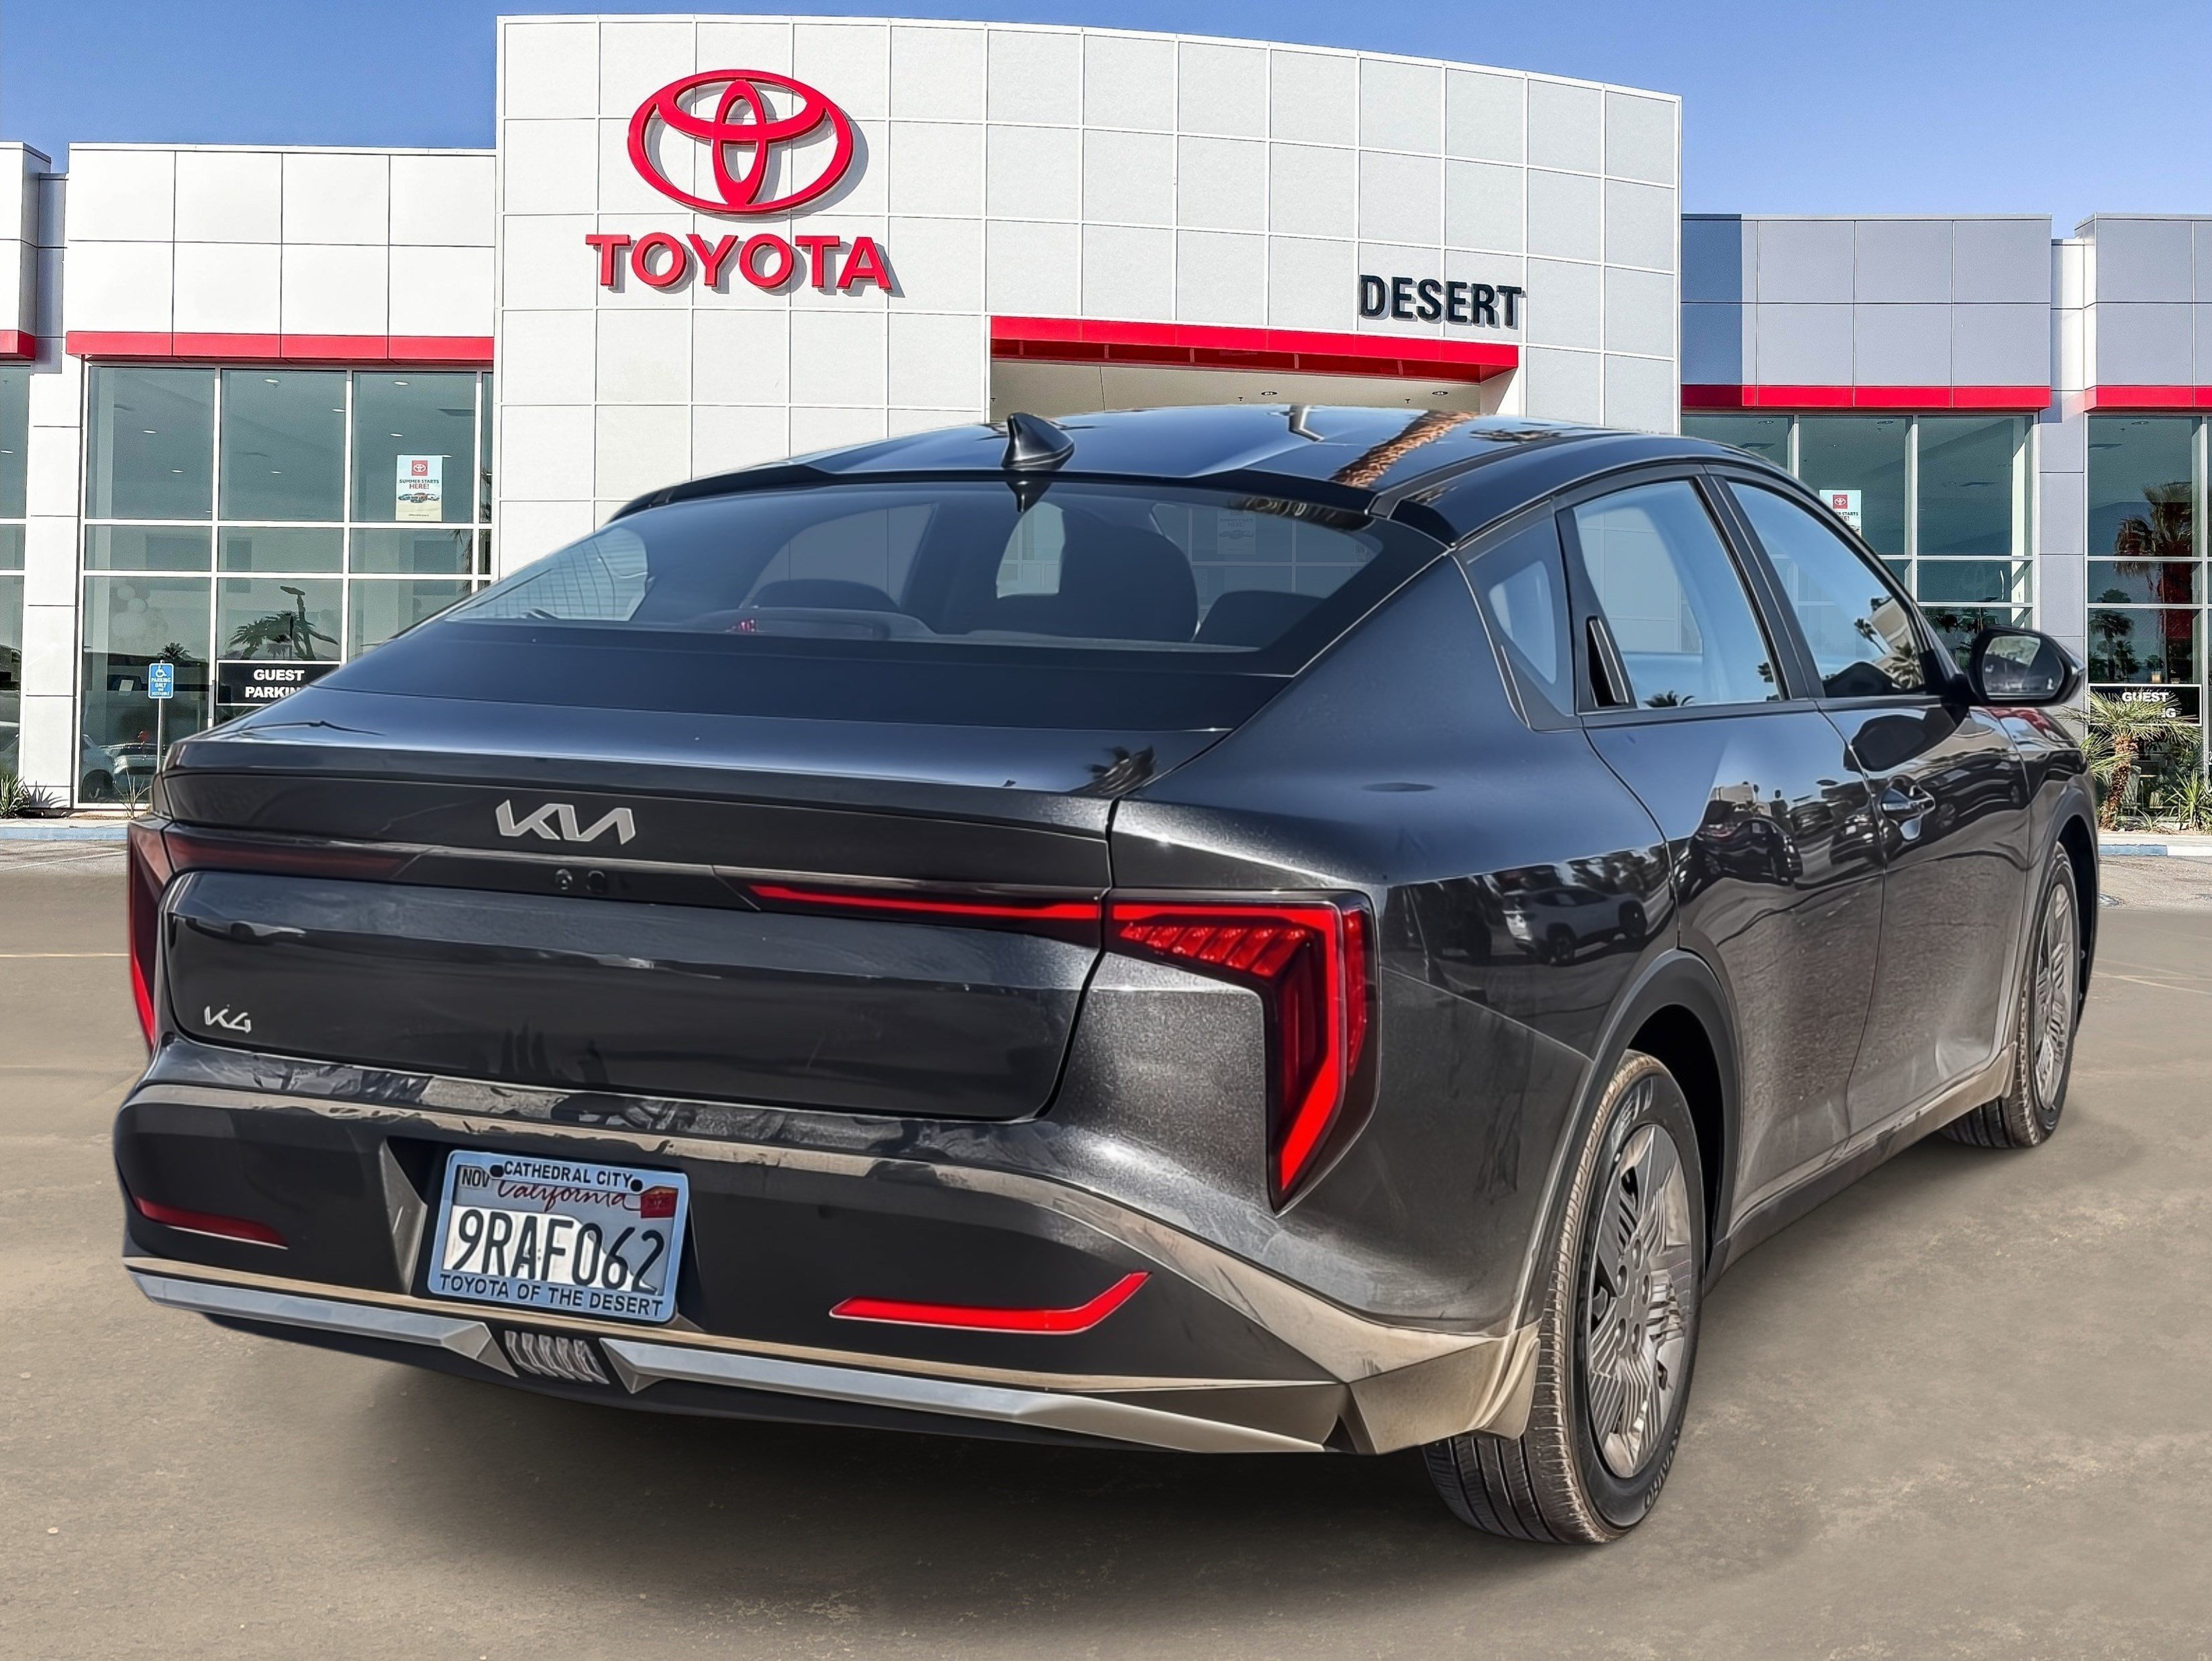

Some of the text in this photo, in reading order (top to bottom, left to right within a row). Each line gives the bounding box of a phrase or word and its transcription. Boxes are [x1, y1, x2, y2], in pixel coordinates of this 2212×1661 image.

[585, 232, 893, 290] TOYOTA
[1359, 274, 1522, 327] DESERT
[253, 669, 305, 681] GUEST
[245, 686, 301, 698] PARKIN
[2121, 691, 2170, 703] GUEST
[495, 799, 636, 846] KIA
[204, 1005, 252, 1034] K4
[461, 1168, 490, 1188] NOV
[505, 1160, 633, 1188] CATHEDRAL CITY
[498, 1179, 642, 1212] California
[452, 1209, 665, 1295] 9RAF062
[440, 1273, 664, 1317] TOYOTA OF THE DESERT
